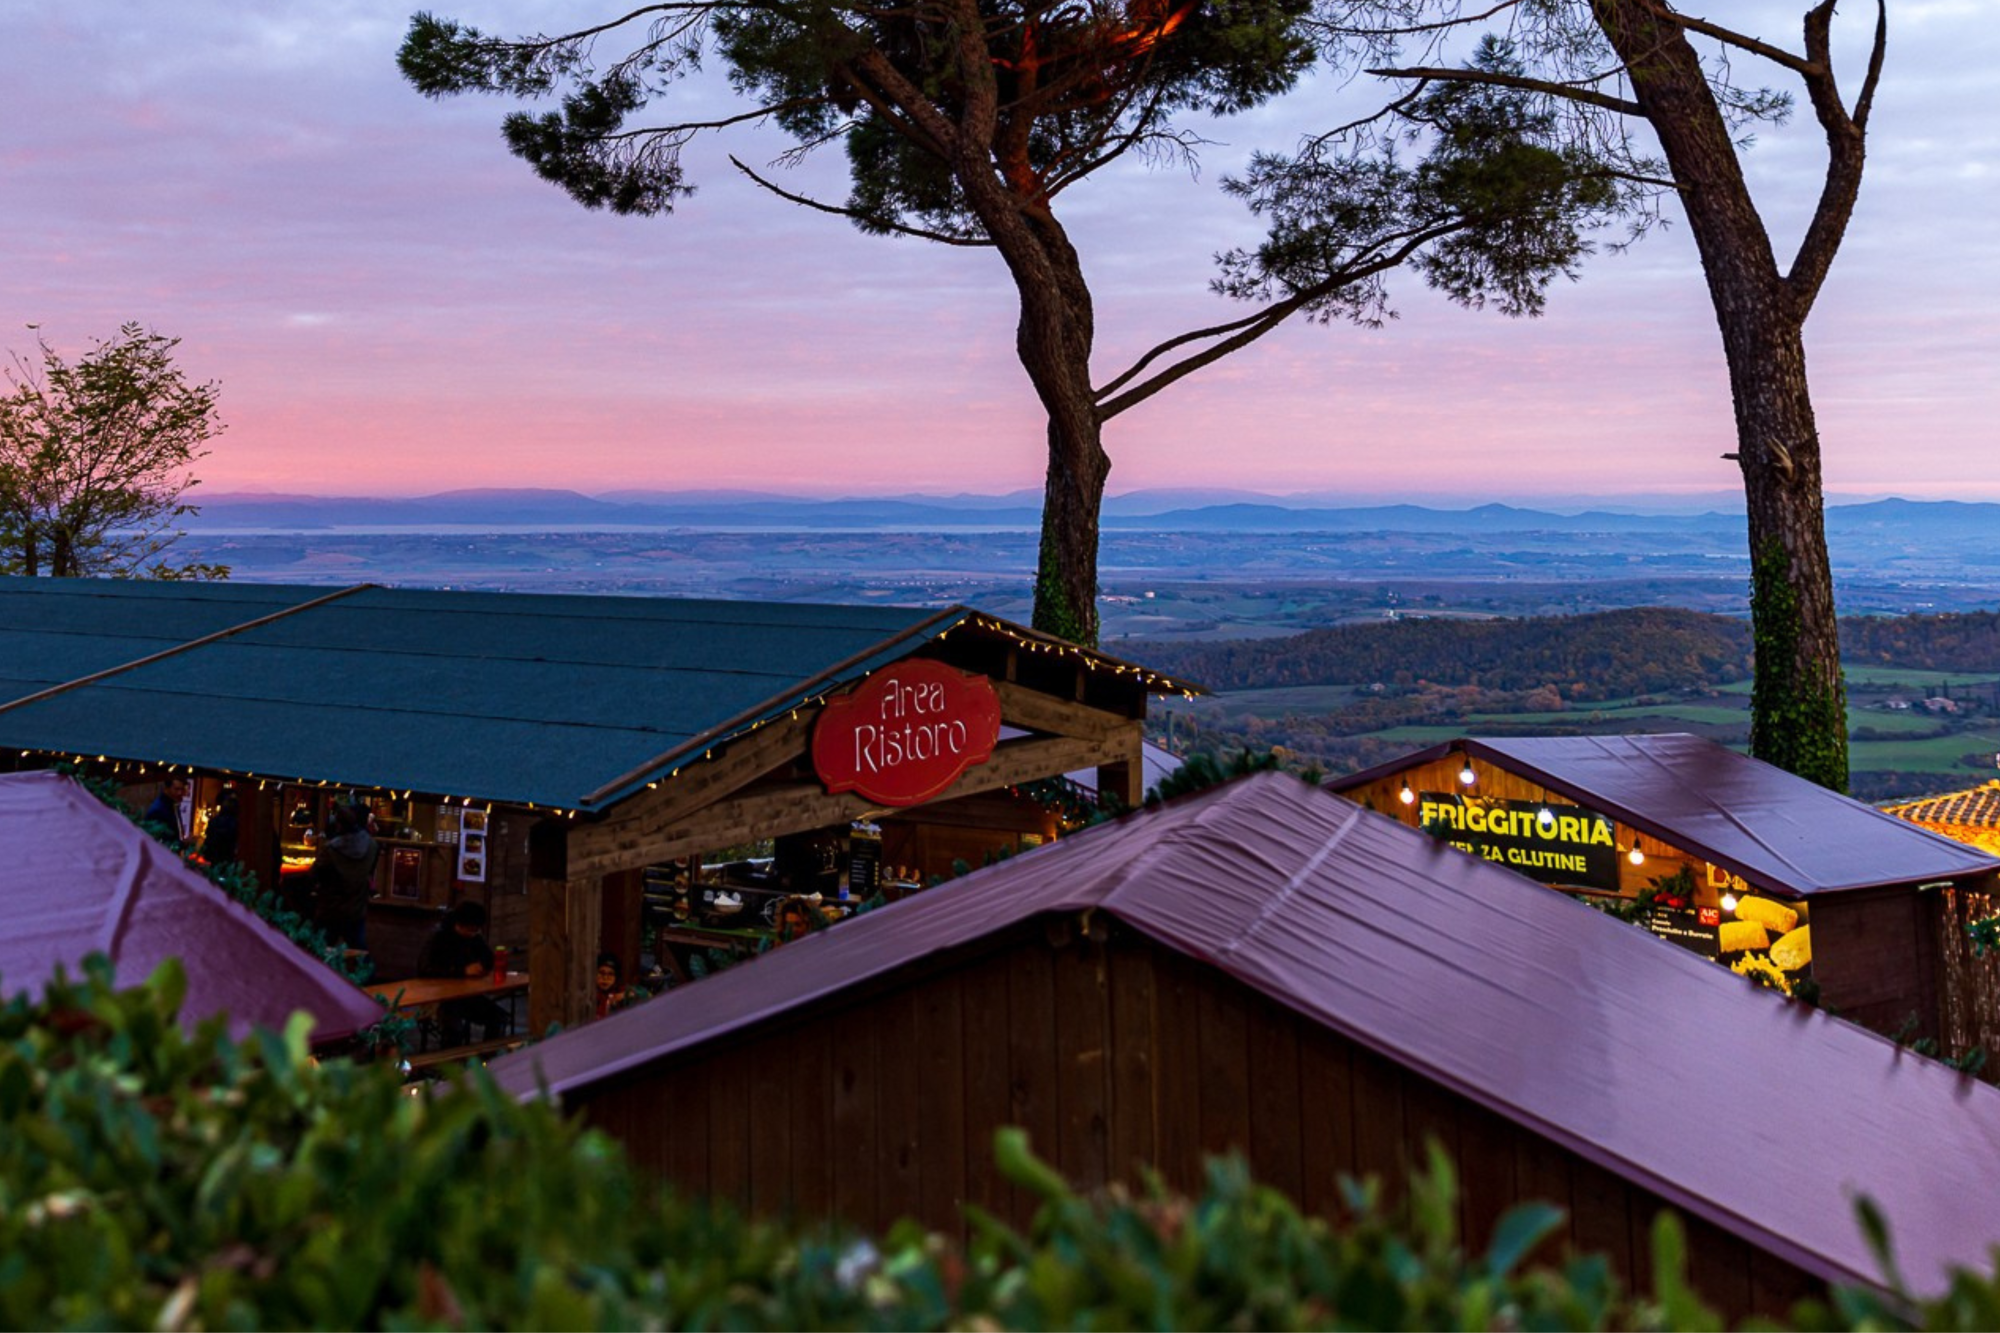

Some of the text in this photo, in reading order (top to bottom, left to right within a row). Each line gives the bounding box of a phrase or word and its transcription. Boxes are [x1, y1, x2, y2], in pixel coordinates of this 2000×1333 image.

[881, 679, 945, 720] Area
[855, 720, 967, 773] Ristoro
[1421, 801, 1613, 846] FRIGGITORIA
[1508, 848, 1587, 872] GLUTINE
